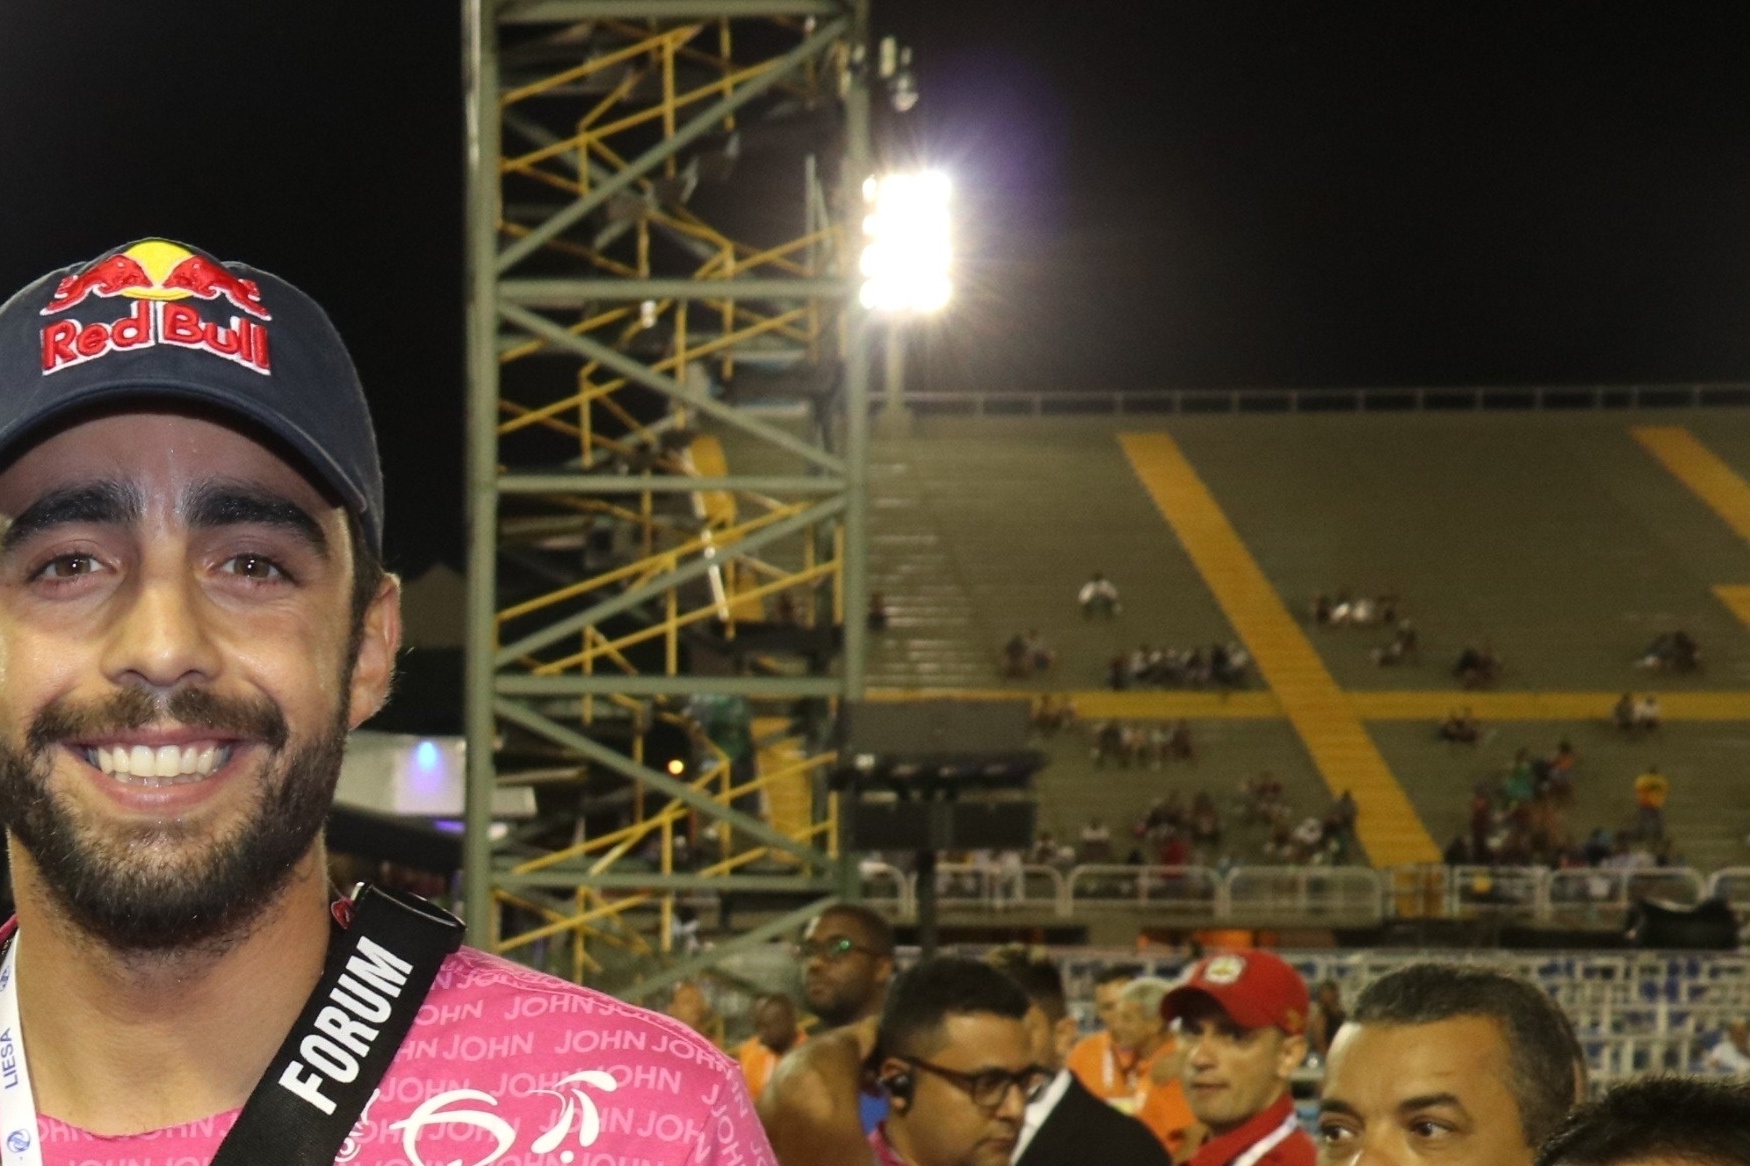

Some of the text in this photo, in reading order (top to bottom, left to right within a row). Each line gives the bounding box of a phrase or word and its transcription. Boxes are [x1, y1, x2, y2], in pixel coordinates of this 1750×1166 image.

[40, 300, 271, 376] Red Bull
[0, 1027, 18, 1089] LIESA
[278, 936, 413, 1116] FORUM
[443, 1030, 646, 1061] JOHN JOHN
